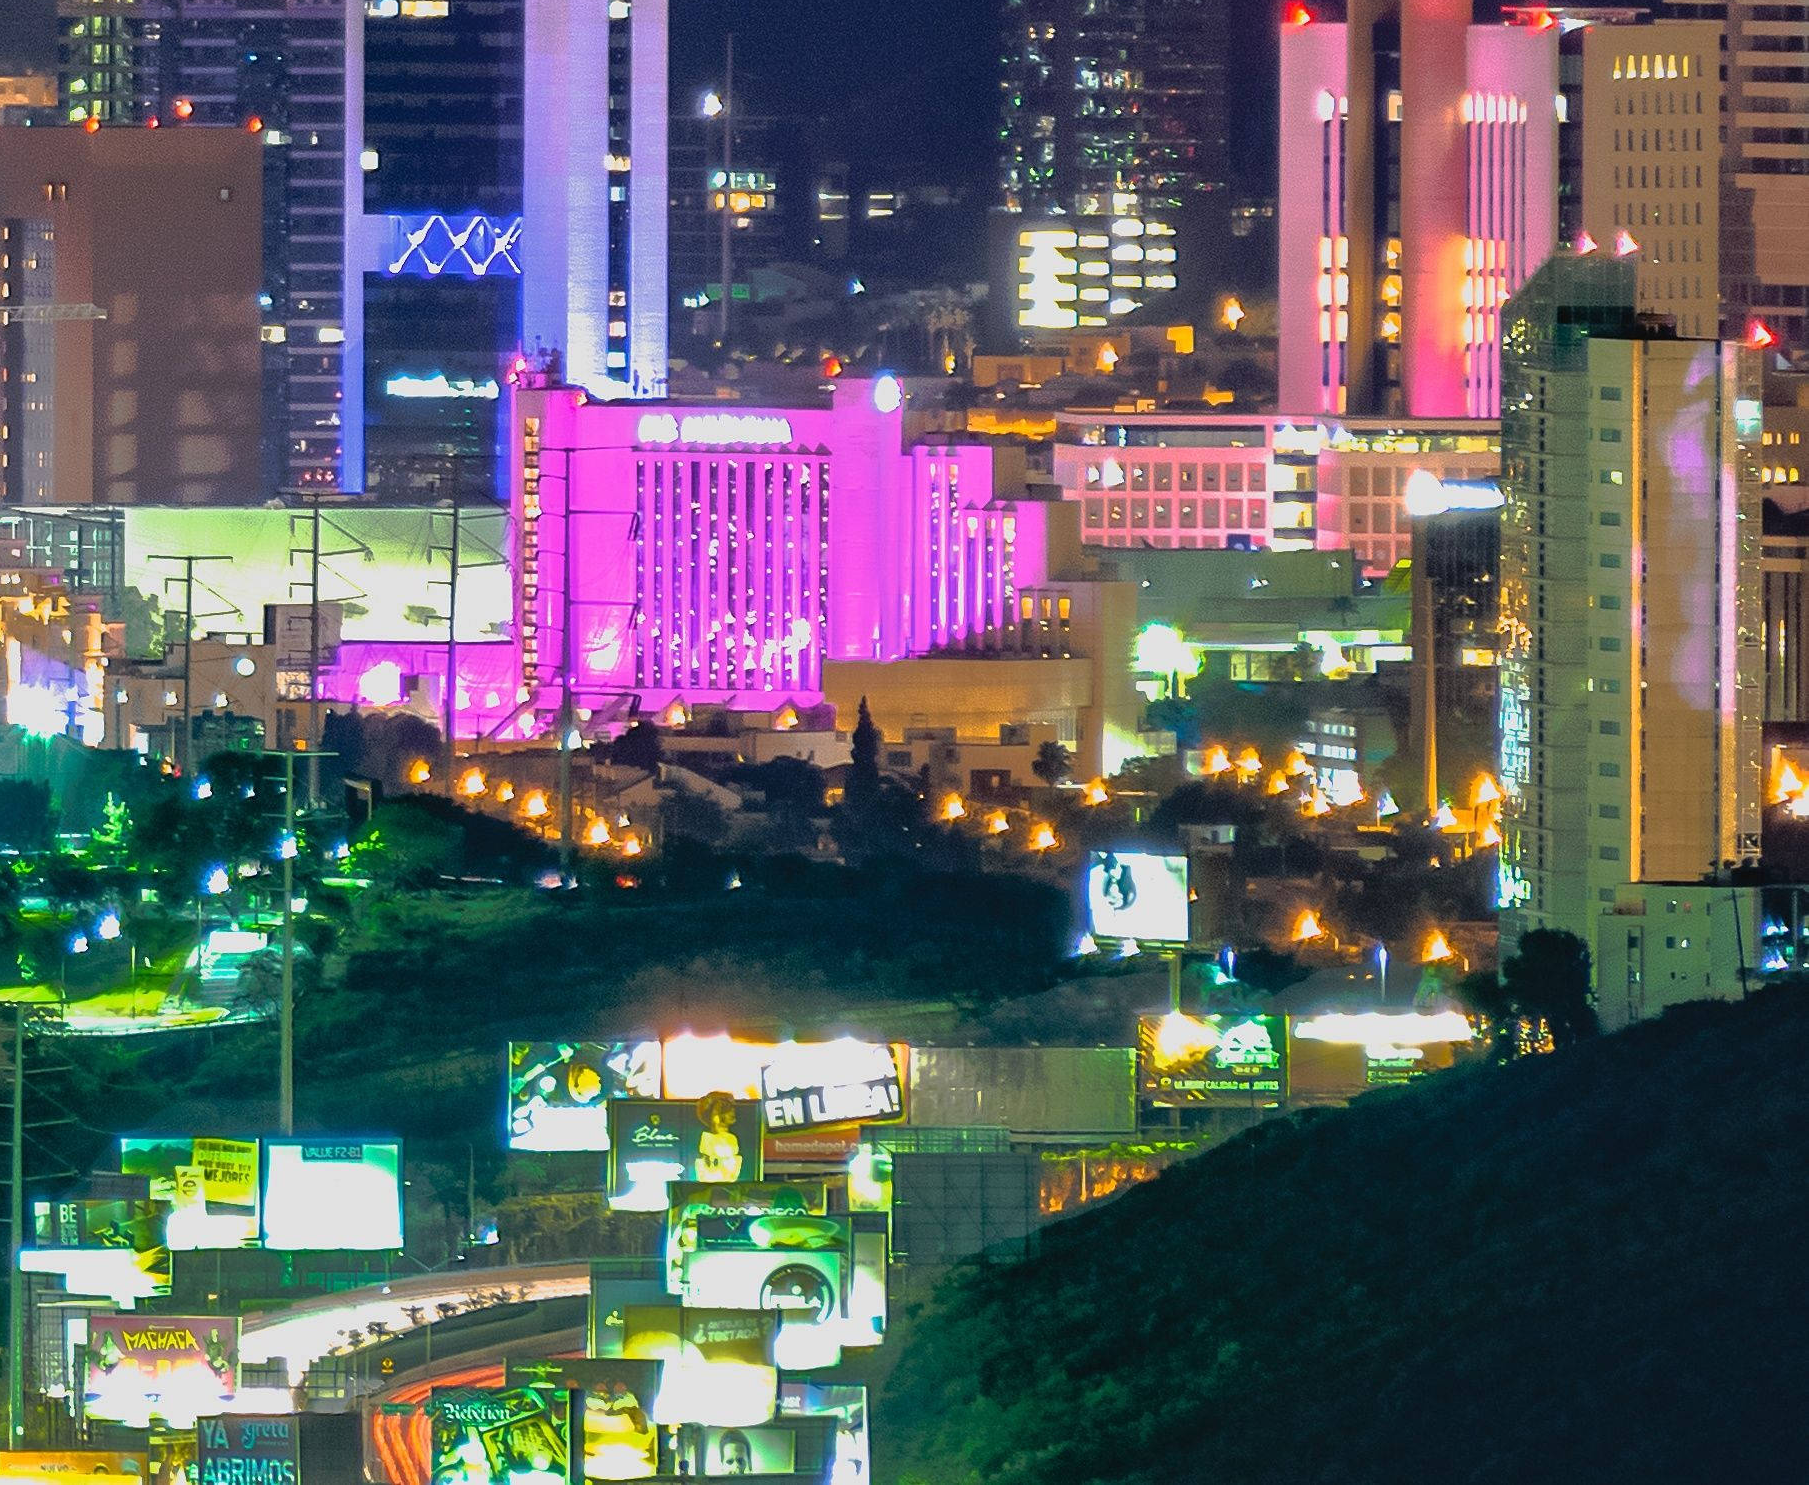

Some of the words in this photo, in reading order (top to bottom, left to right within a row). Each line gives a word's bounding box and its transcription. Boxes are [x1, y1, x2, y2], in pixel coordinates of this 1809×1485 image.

[765, 1096, 806, 1128] EN
[59, 1204, 78, 1223] BE
[201, 1419, 230, 1449] YA
[202, 1457, 295, 1485] ABRIMOS
